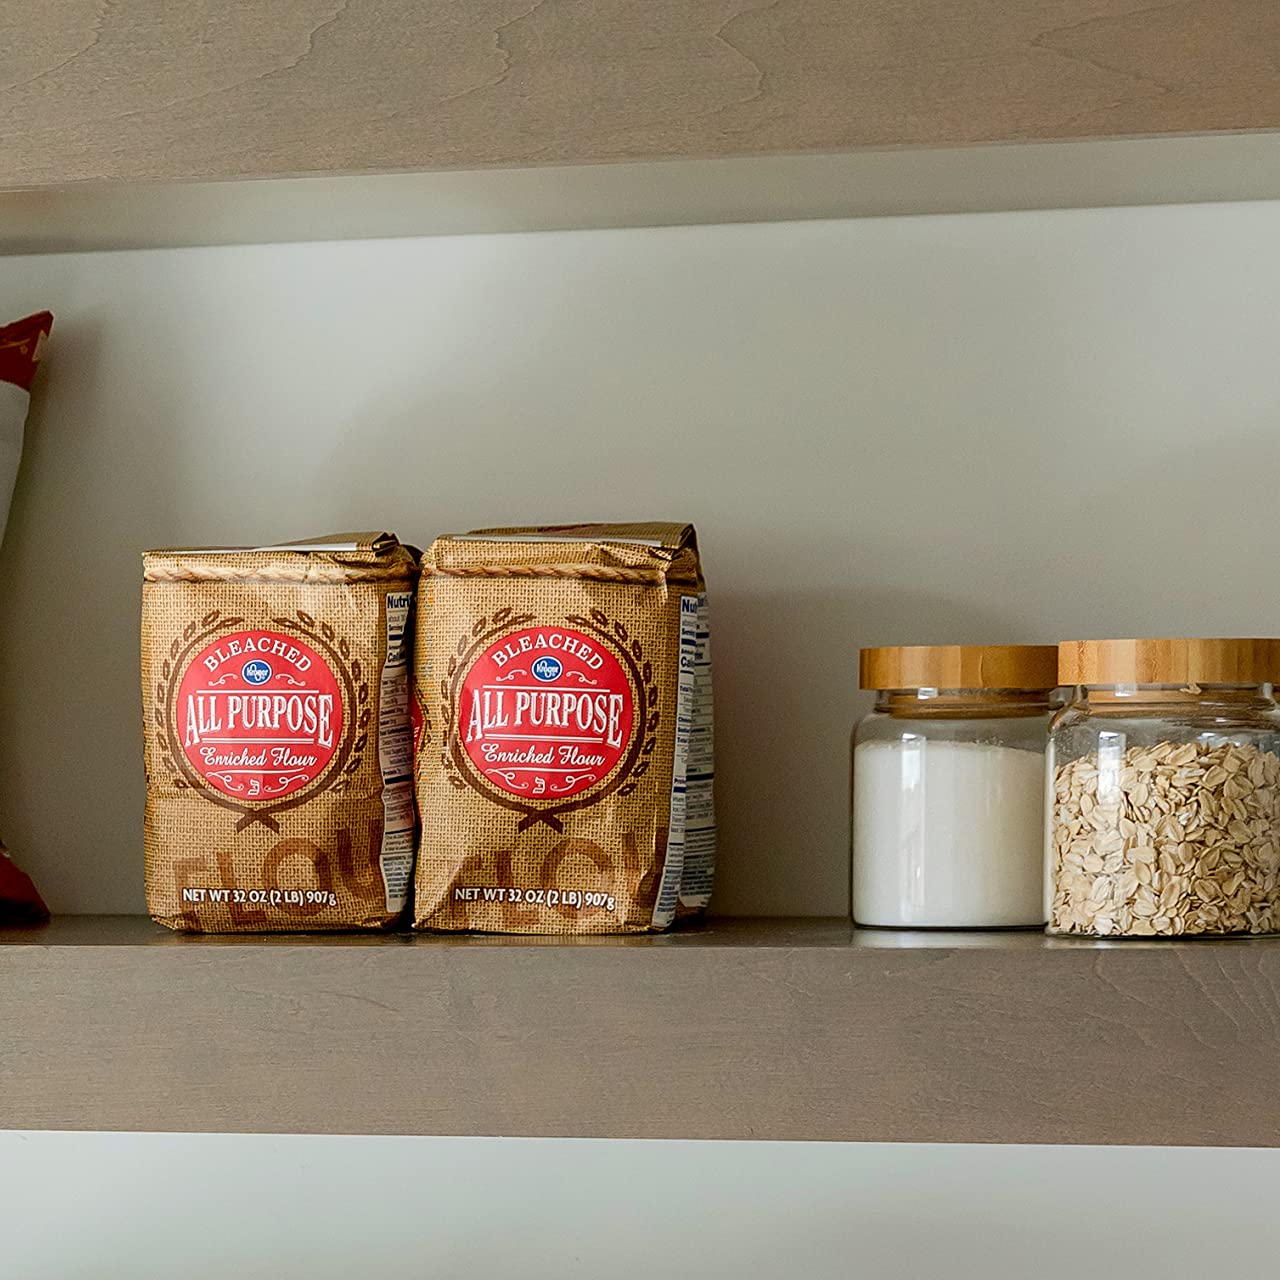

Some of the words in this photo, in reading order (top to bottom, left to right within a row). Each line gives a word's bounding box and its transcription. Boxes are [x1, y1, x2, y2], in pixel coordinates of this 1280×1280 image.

[203, 637, 312, 672] BLEACHED
[492, 633, 604, 670] BLEACHED
[185, 694, 223, 748] ALL
[228, 694, 333, 748] PURPOSE
[466, 688, 509, 744] ALL
[513, 692, 623, 748] PURPOSE
[200, 746, 267, 767] Enriched
[270, 747, 317, 766] Flour
[480, 743, 554, 763] Enriched
[557, 745, 606, 766] Flour
[182, 888, 207, 902] NET
[209, 888, 231, 902] WT
[233, 889, 245, 903] 32
[248, 889, 267, 903] OZ
[269, 890, 282, 906] (2
[284, 890, 304, 906] LB)
[306, 891, 337, 907] 907g
[455, 888, 480, 900] NET
[483, 888, 505, 901] WT
[508, 889, 521, 902] 32
[525, 890, 544, 904] OZ
[546, 891, 559, 908] (2
[561, 891, 582, 909] LB)
[585, 892, 615, 911] 907g
